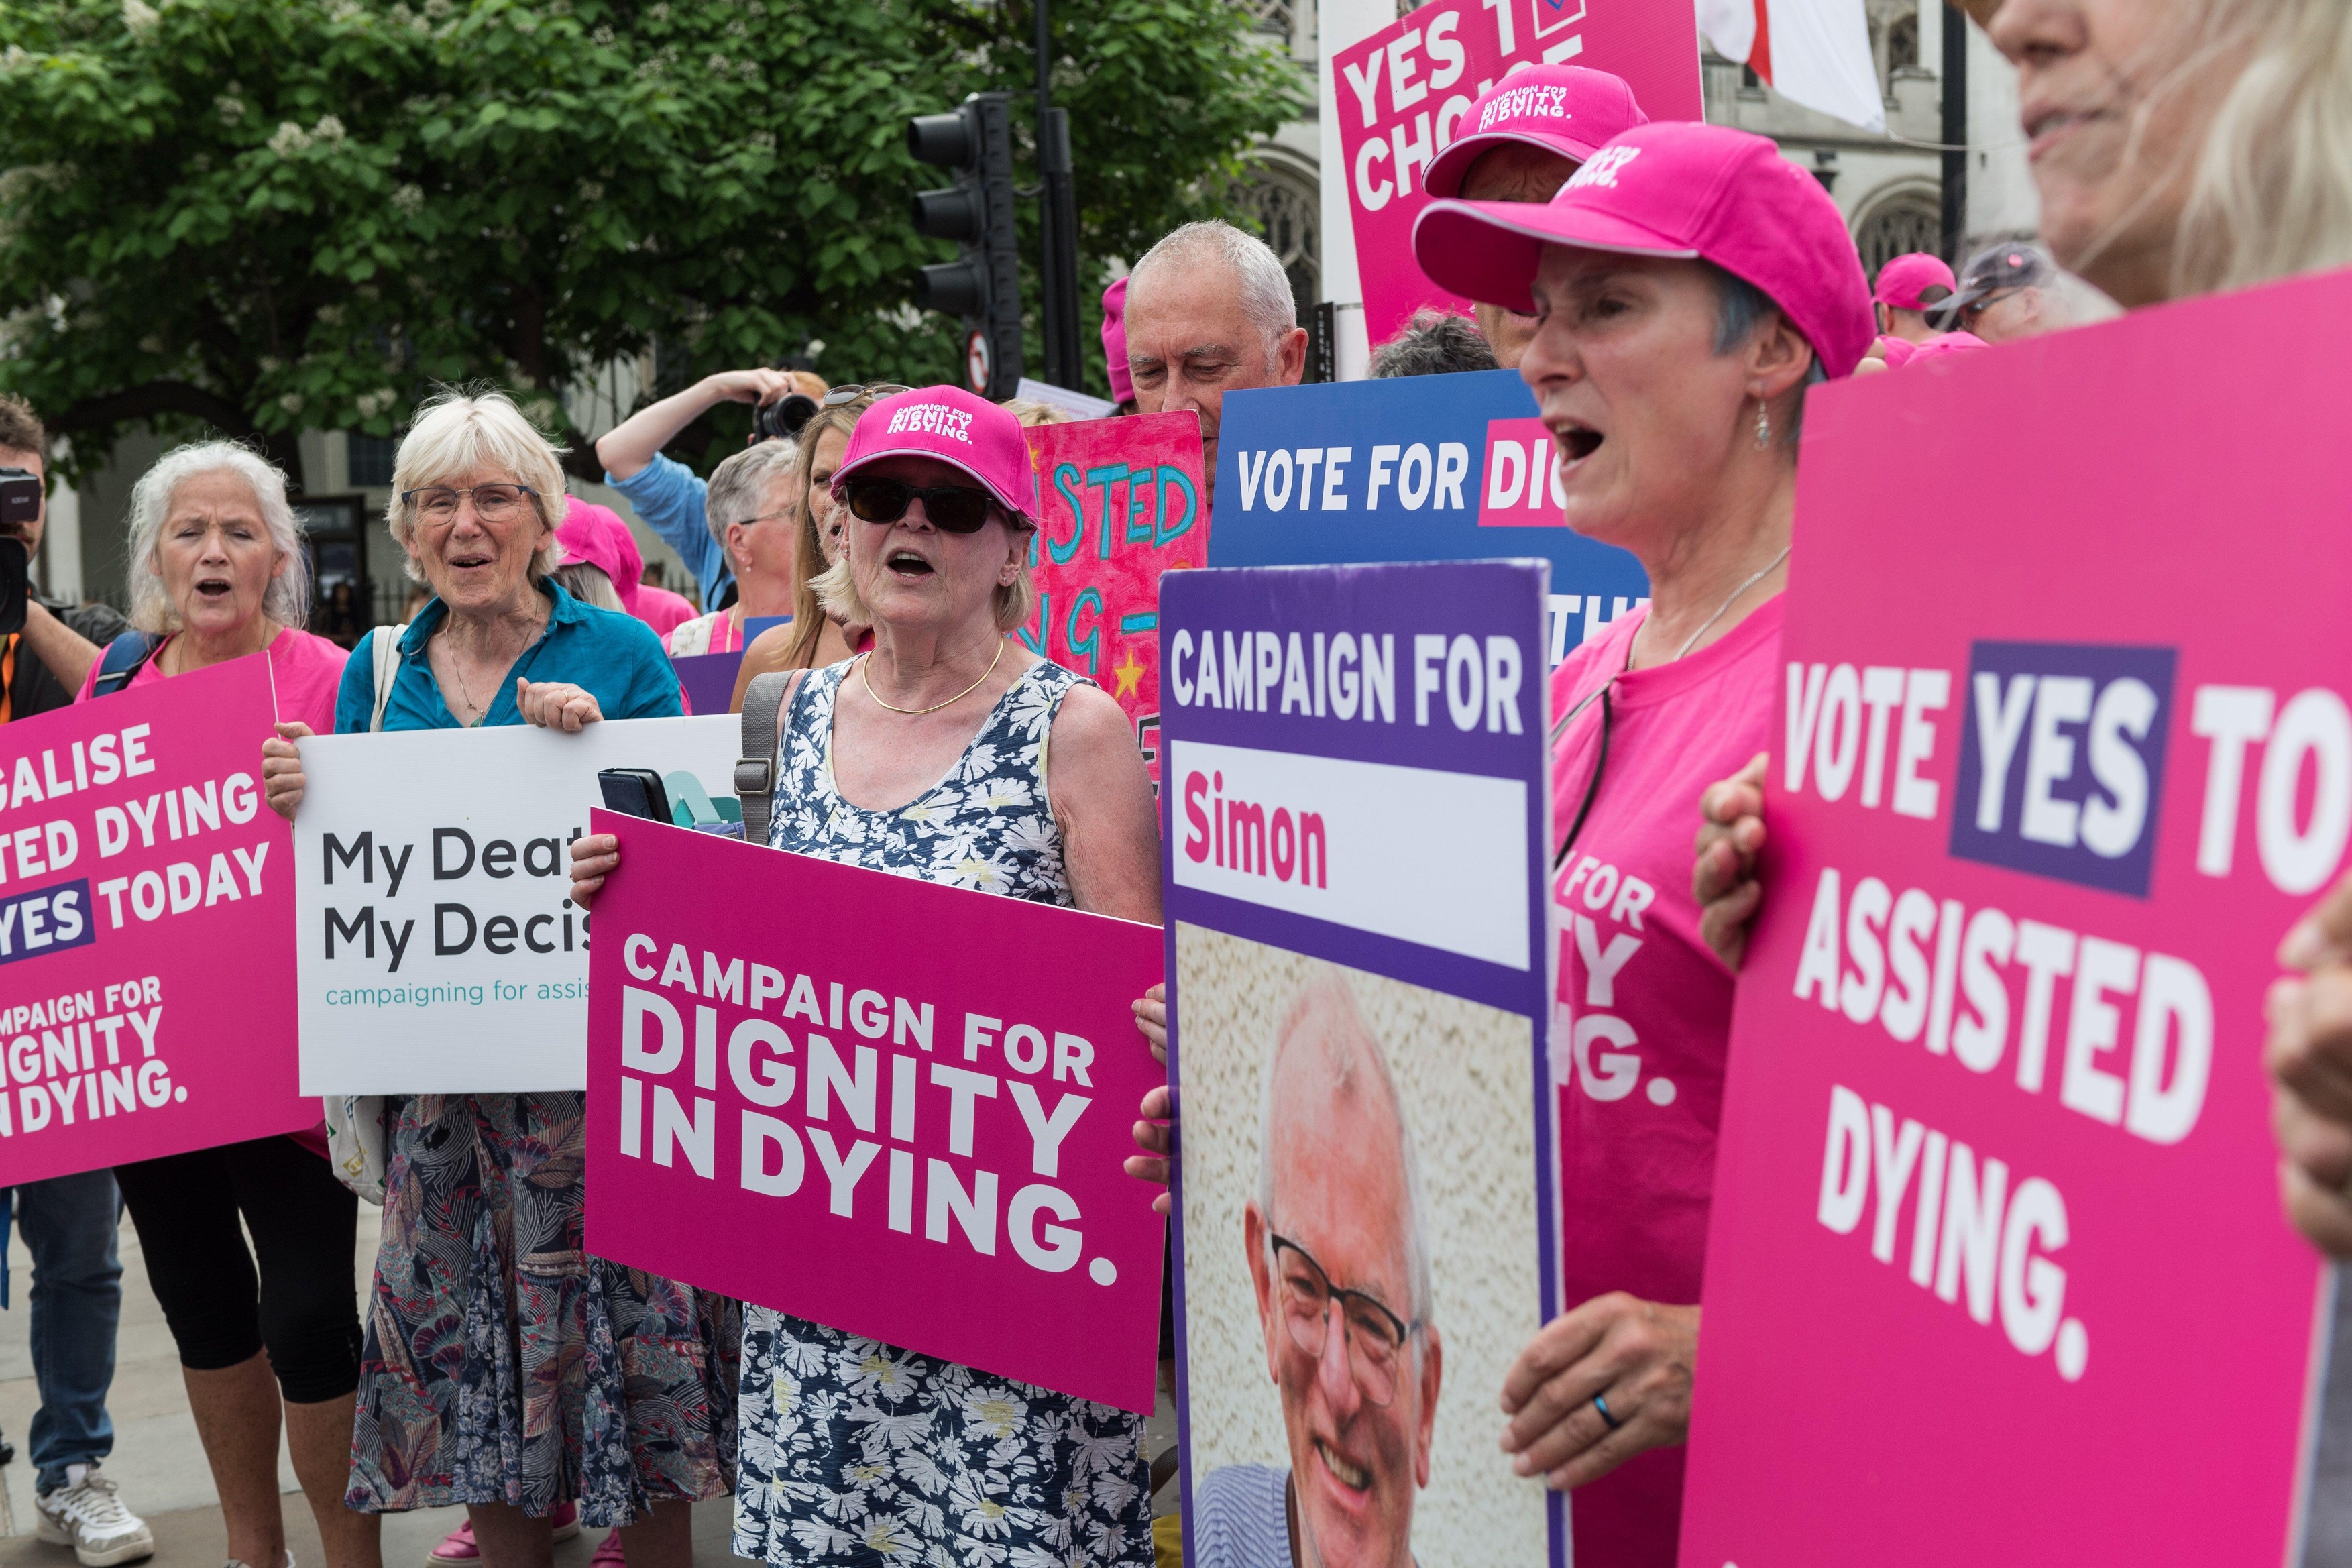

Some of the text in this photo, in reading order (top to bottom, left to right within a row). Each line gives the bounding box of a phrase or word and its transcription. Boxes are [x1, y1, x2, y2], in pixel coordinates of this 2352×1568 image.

[1343, 11, 1465, 128] YES
[1481, 93, 1567, 121] DIGNITY
[1484, 85, 1567, 109] CAMPAIGN FOR
[1478, 104, 1572, 134] IN DYING.
[887, 421, 973, 445] IN DYING.
[891, 410, 972, 431] DIGNITY
[896, 403, 973, 421] CAMPAIGN FOR
[1238, 447, 1351, 512] VOTE
[1367, 443, 1469, 510] FOR
[1170, 628, 1524, 736] CAMPAIGN FOR
[0, 722, 156, 814] ALISE
[1784, 662, 2352, 895] VOTE YES TO
[95, 772, 258, 859] DYING
[1184, 769, 1328, 890] Simon
[0, 842, 269, 956] YES TODAY
[323, 830, 414, 898] My
[1562, 855, 1655, 931] FOR
[325, 906, 415, 972] My
[105, 976, 162, 1013] FOR
[326, 982, 484, 1008] campaigning
[493, 980, 528, 1000] for
[624, 932, 1095, 1087] CAMPAIGN FOR
[1793, 867, 2215, 1144] ASSISTED
[19, 1065, 188, 1134] DYING.
[621, 985, 1093, 1178] DIGNITY
[620, 1076, 1118, 1287] IN DYING.
[1817, 1084, 2088, 1382] DYING.
